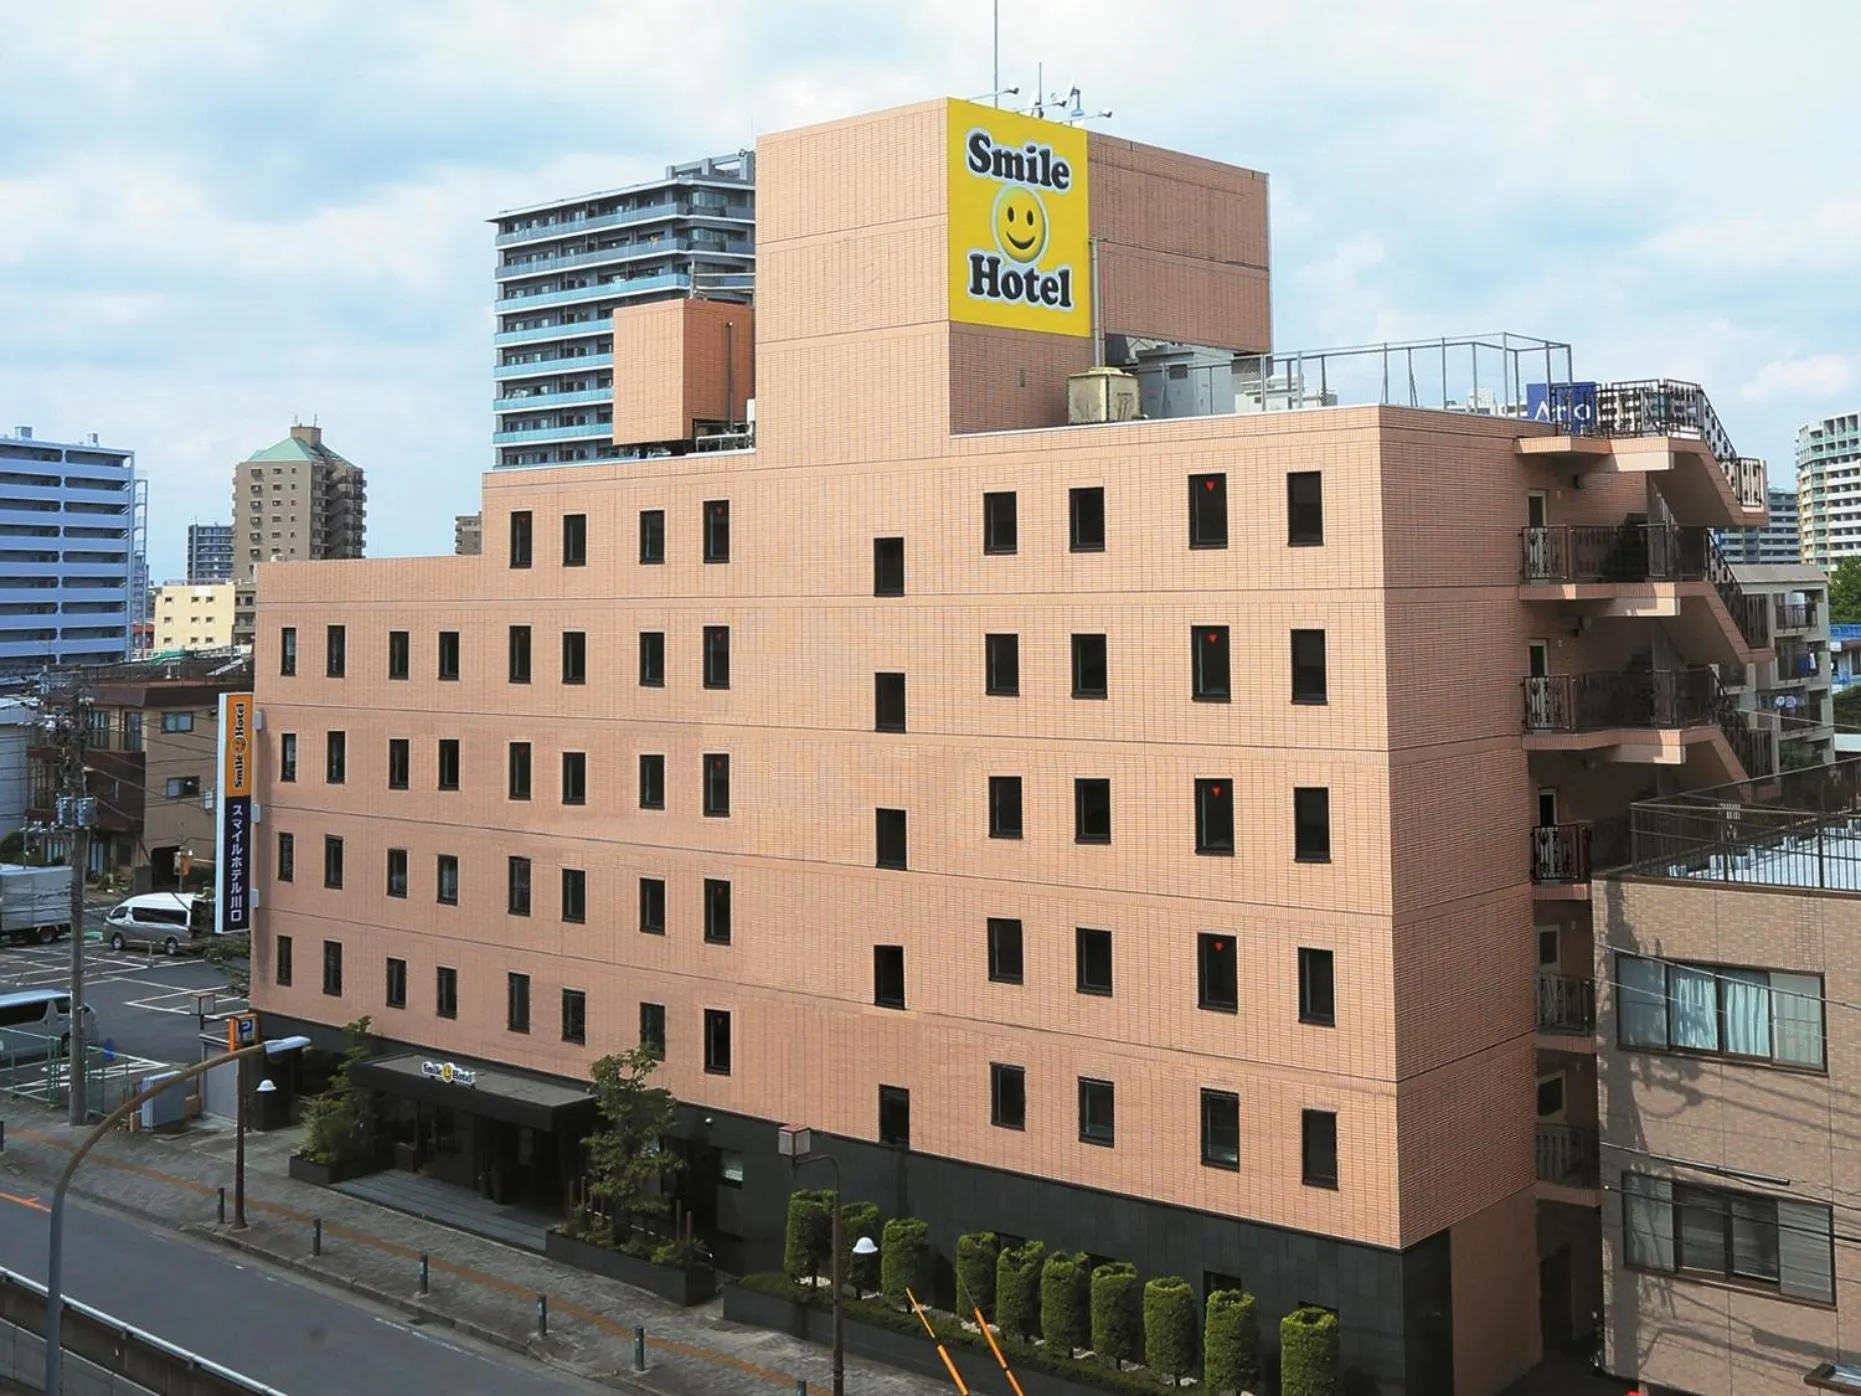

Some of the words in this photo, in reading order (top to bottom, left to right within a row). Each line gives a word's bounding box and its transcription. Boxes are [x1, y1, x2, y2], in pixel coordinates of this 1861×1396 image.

[967, 131, 1070, 190] Smile
[969, 252, 1072, 308] Hotel
[235, 703, 245, 737] Hotel
[234, 754, 244, 788] Smile
[230, 804, 243, 921] スマイルホテル川口
